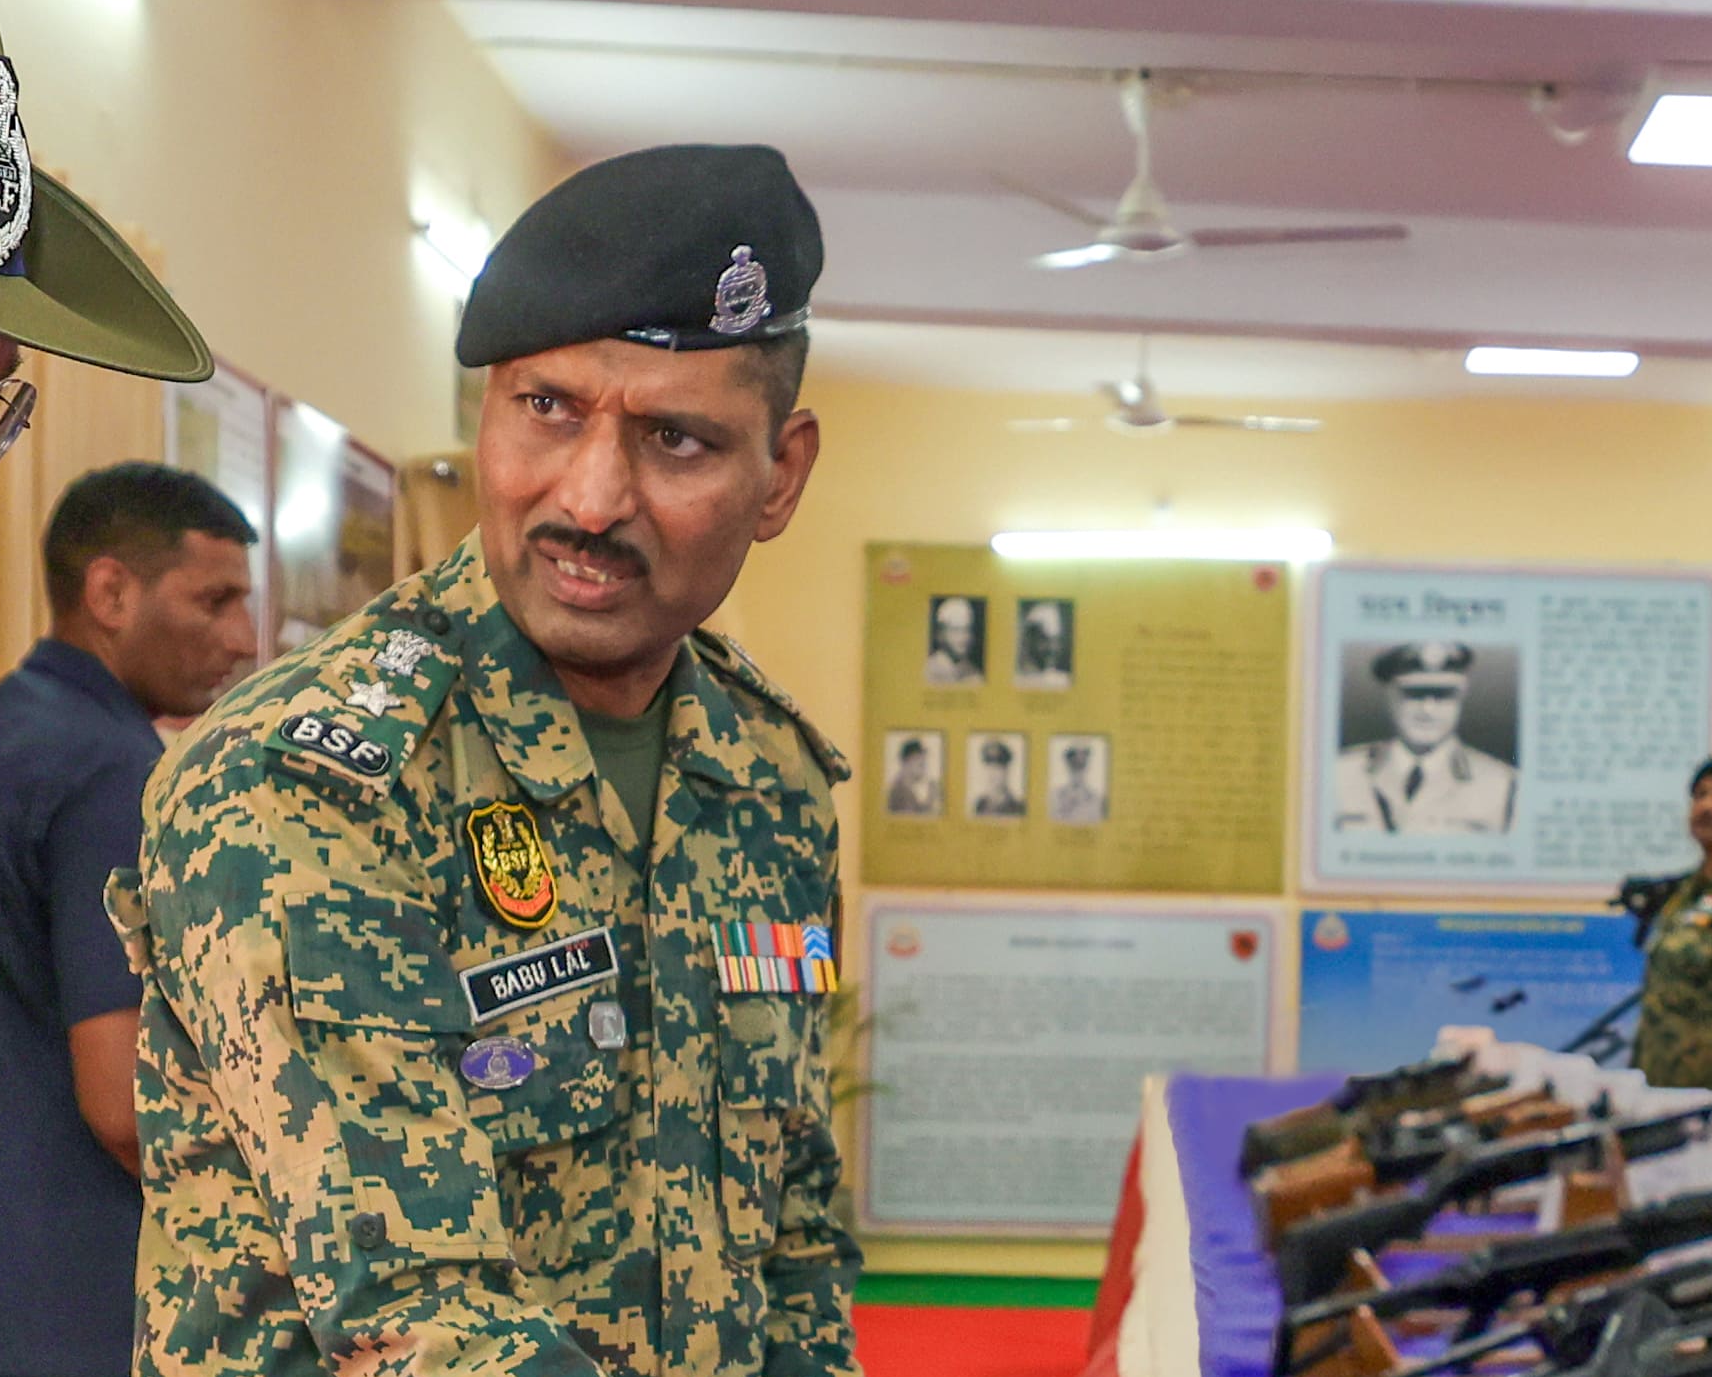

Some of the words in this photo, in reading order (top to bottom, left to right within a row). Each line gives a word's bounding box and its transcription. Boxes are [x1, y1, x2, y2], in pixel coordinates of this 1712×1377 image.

[292, 716, 384, 761] BSF
[497, 849, 528, 872] BSF
[489, 960, 547, 1000] BABU
[550, 948, 591, 979] LAL
